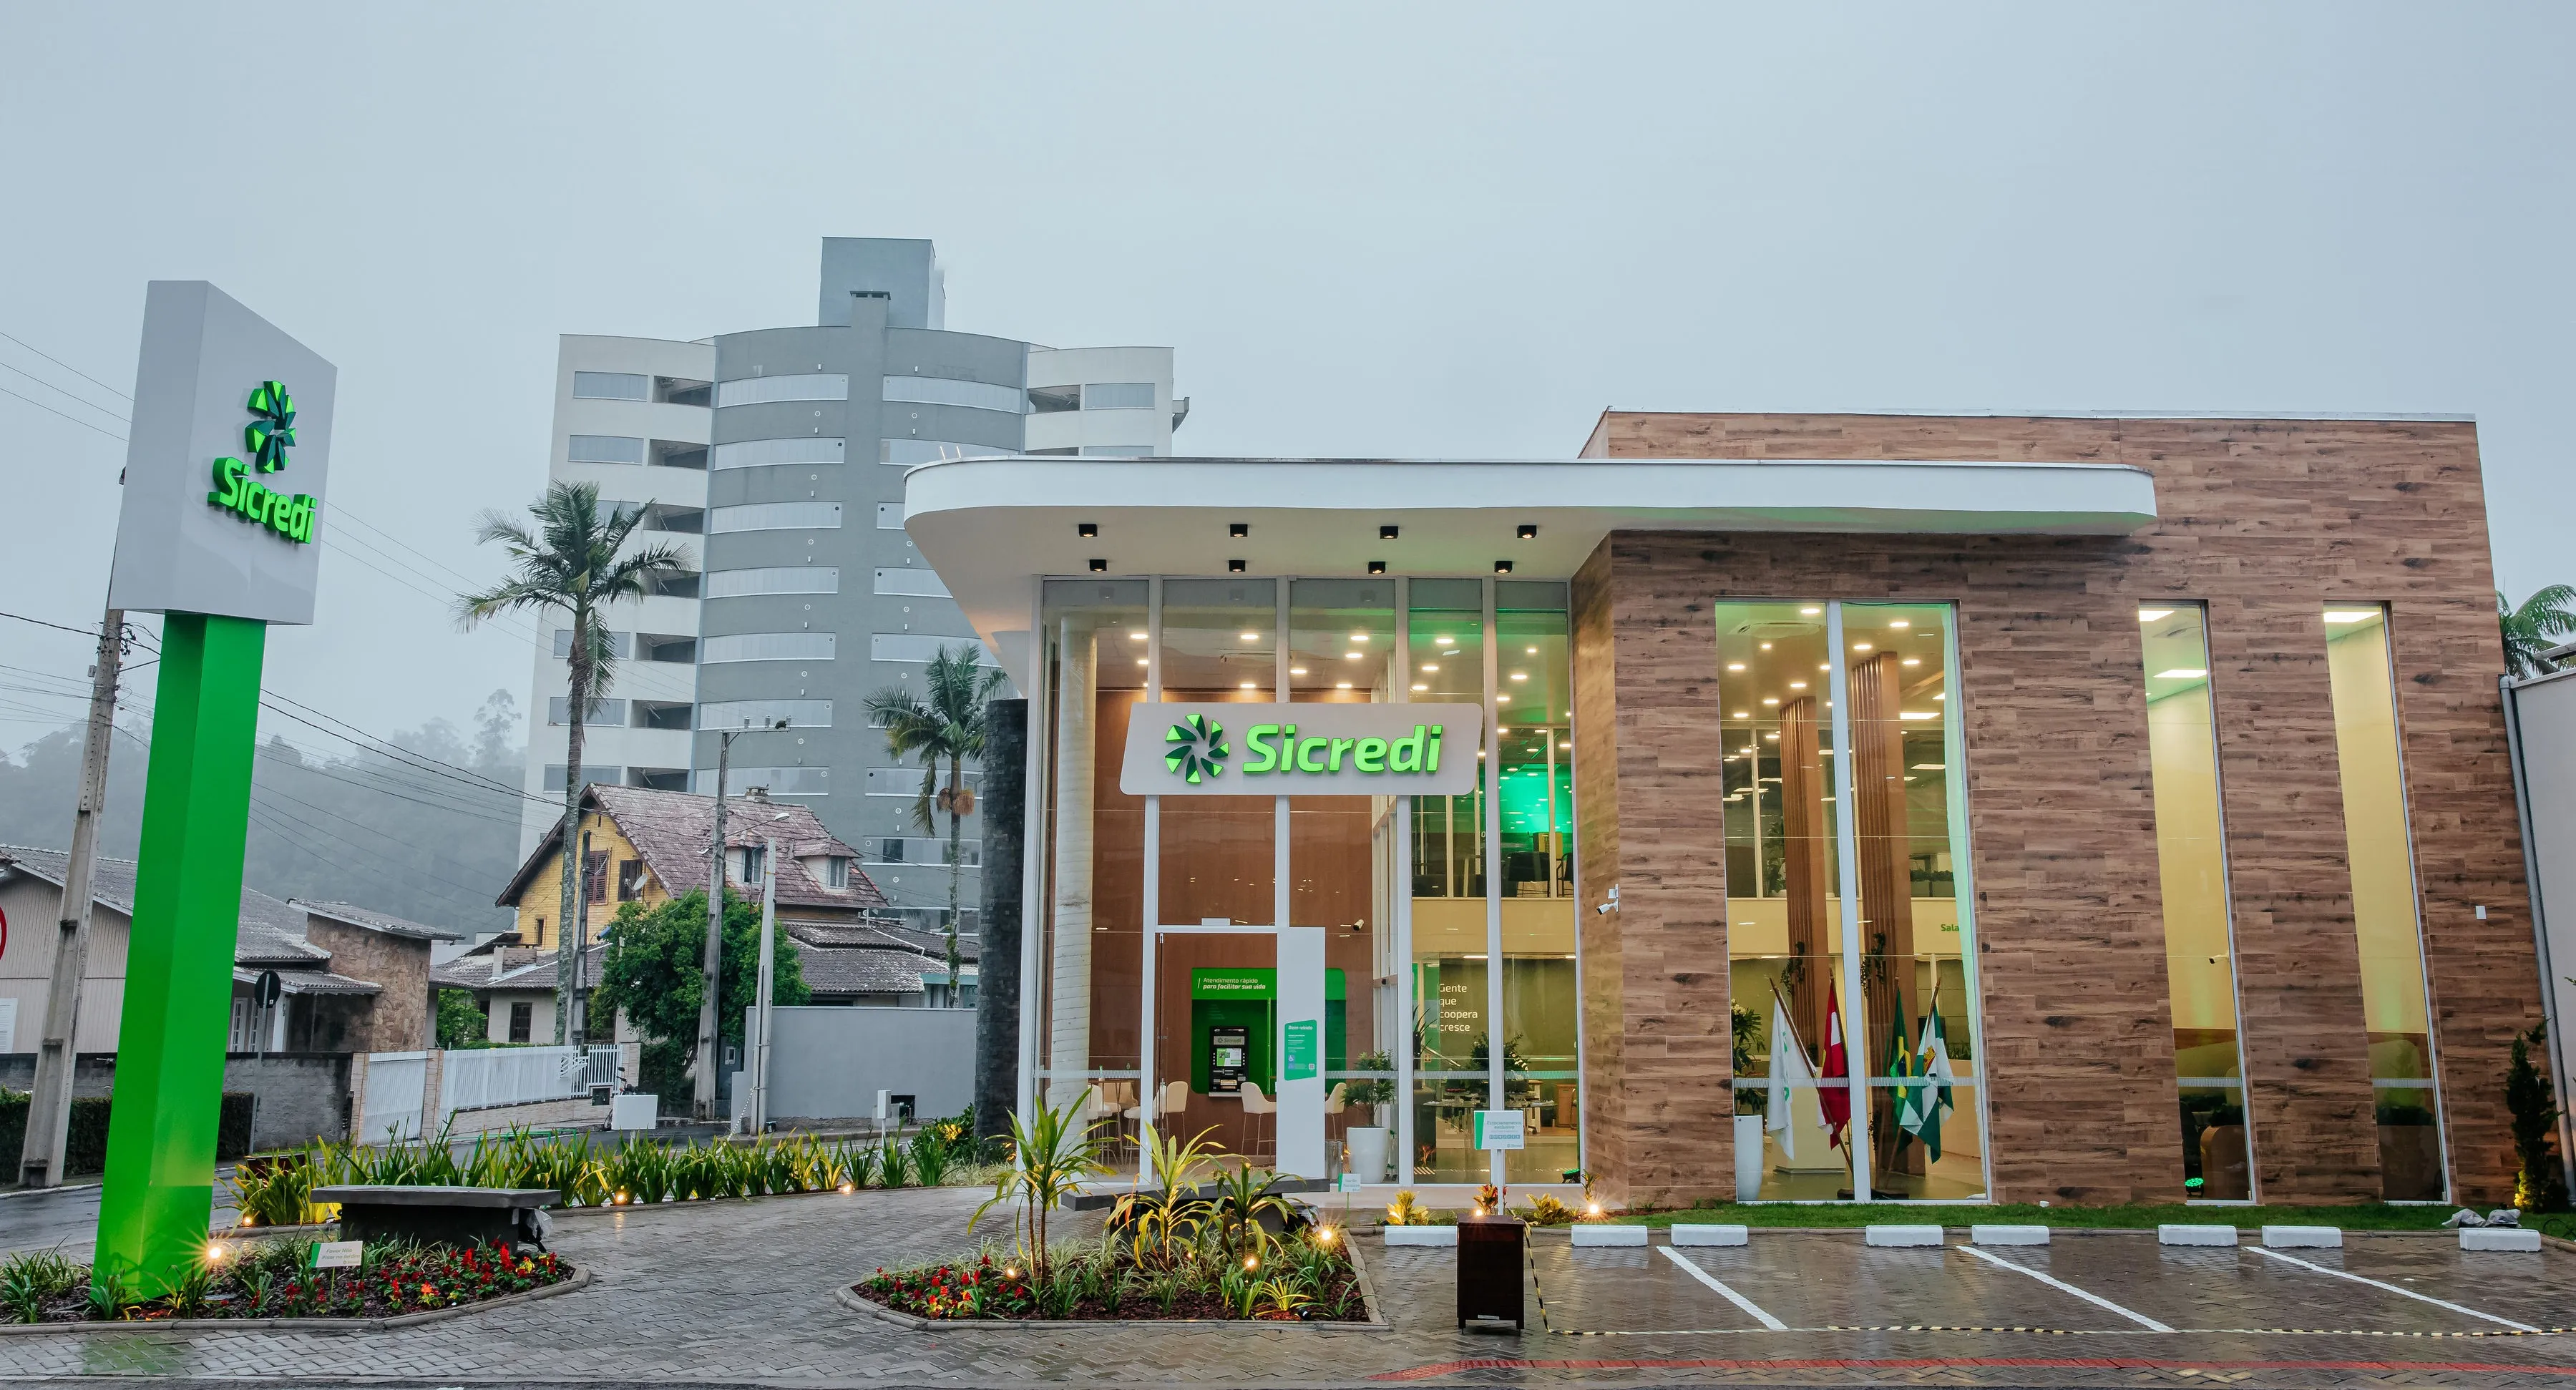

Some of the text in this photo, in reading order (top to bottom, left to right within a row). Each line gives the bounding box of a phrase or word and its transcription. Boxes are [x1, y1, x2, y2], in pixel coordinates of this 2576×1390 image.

[208, 456, 318, 544] Sicredi
[1243, 724, 1443, 774] Sicredi
[1440, 983, 1468, 993] Gente
[1440, 998, 1457, 1007] que
[1440, 1011, 1478, 1020] coopera
